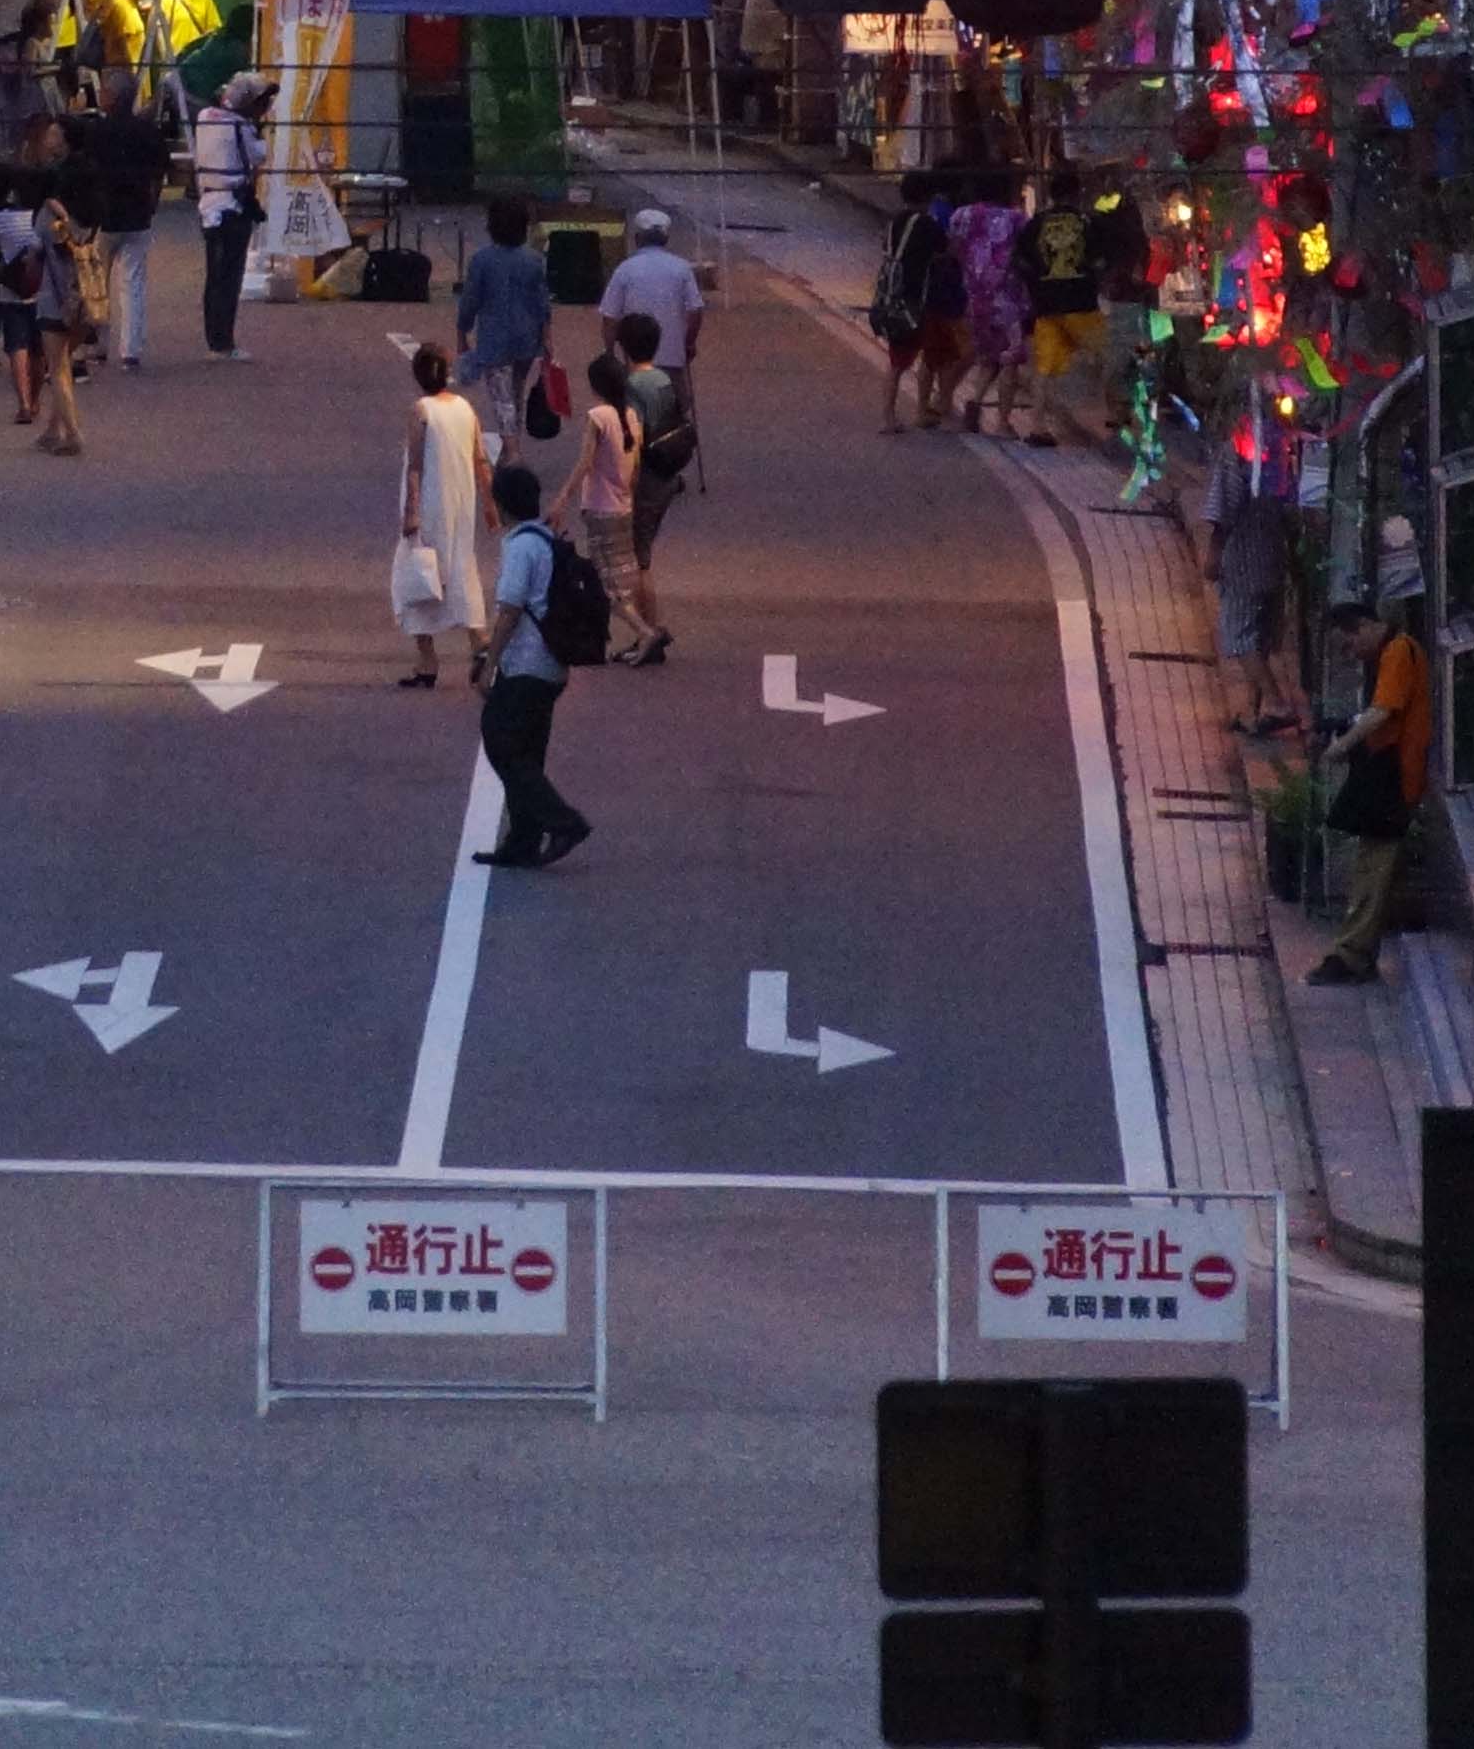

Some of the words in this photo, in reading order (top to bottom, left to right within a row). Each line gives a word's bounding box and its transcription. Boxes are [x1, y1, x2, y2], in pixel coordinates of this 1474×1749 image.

[365, 1224, 504, 1278] 通行止
[1043, 1229, 1181, 1284] 通行止
[368, 1289, 497, 1315] 高岡警察署
[1046, 1294, 1177, 1321] 高岡警察署
